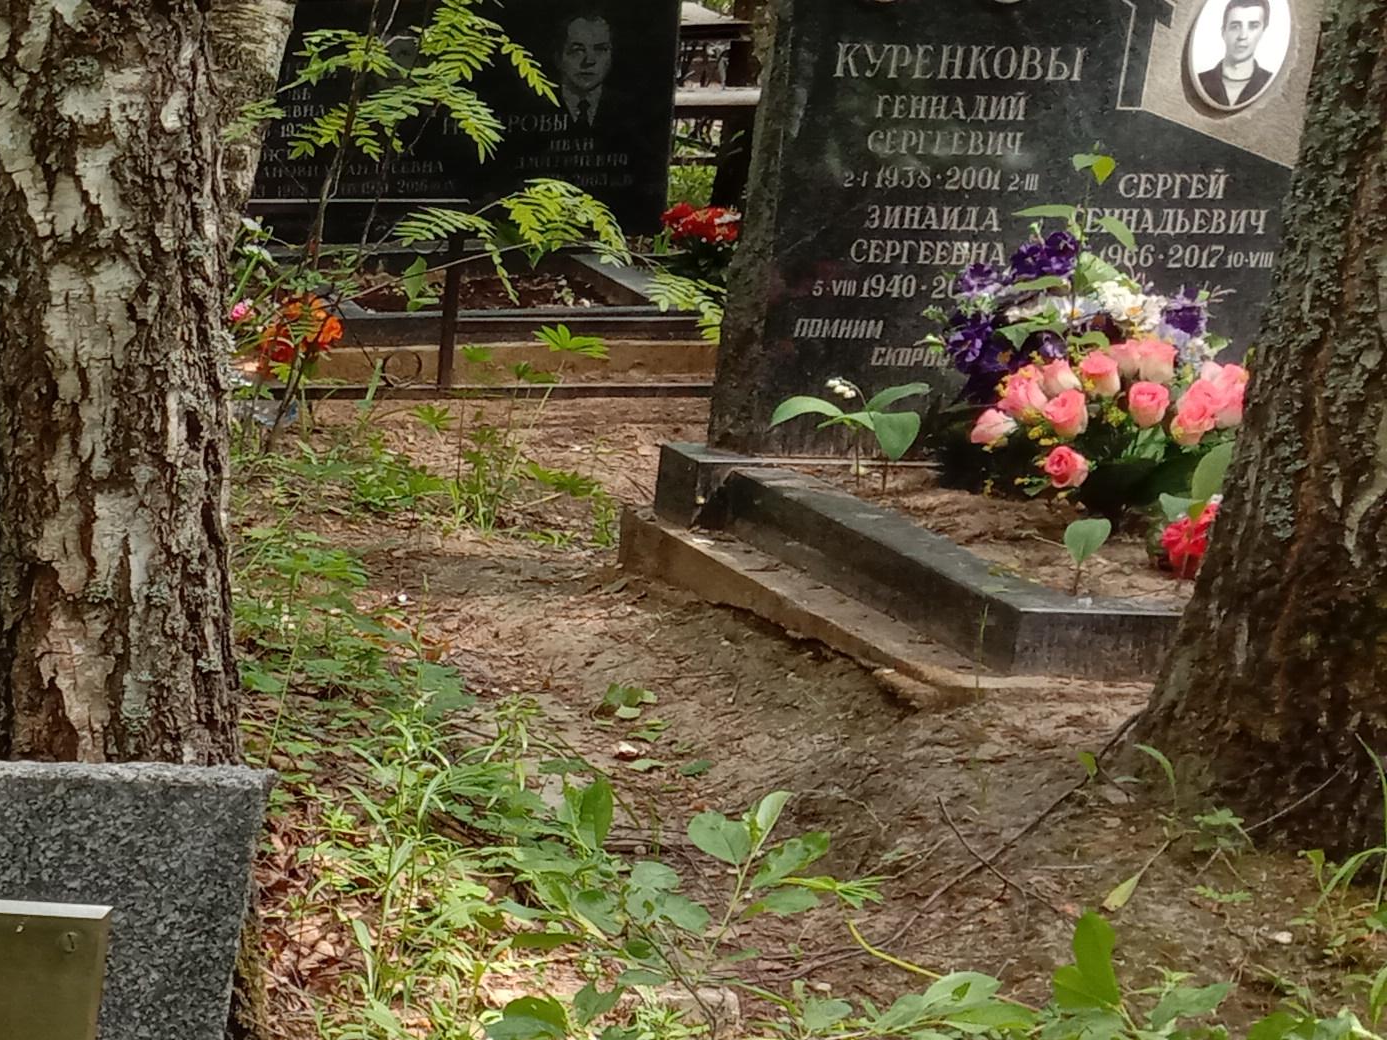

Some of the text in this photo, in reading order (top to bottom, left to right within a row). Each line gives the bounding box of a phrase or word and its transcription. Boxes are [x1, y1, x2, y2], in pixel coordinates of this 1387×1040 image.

[832, 42, 1088, 81] КУРЕНКОВЫ
[875, 91, 1030, 123] ГЕННАДИЙ
[867, 129, 1025, 156] СЕРГЕЕВИЧ
[1118, 169, 1230, 199] СЕРГЕЙ
[864, 204, 1002, 233] ЗИНАИДА
[1077, 208, 1270, 236] ЕННАДЬЕВИЧ
[850, 239, 1006, 266] СЕРГЕЕВНА
[793, 318, 884, 340] ПОМНИМ
